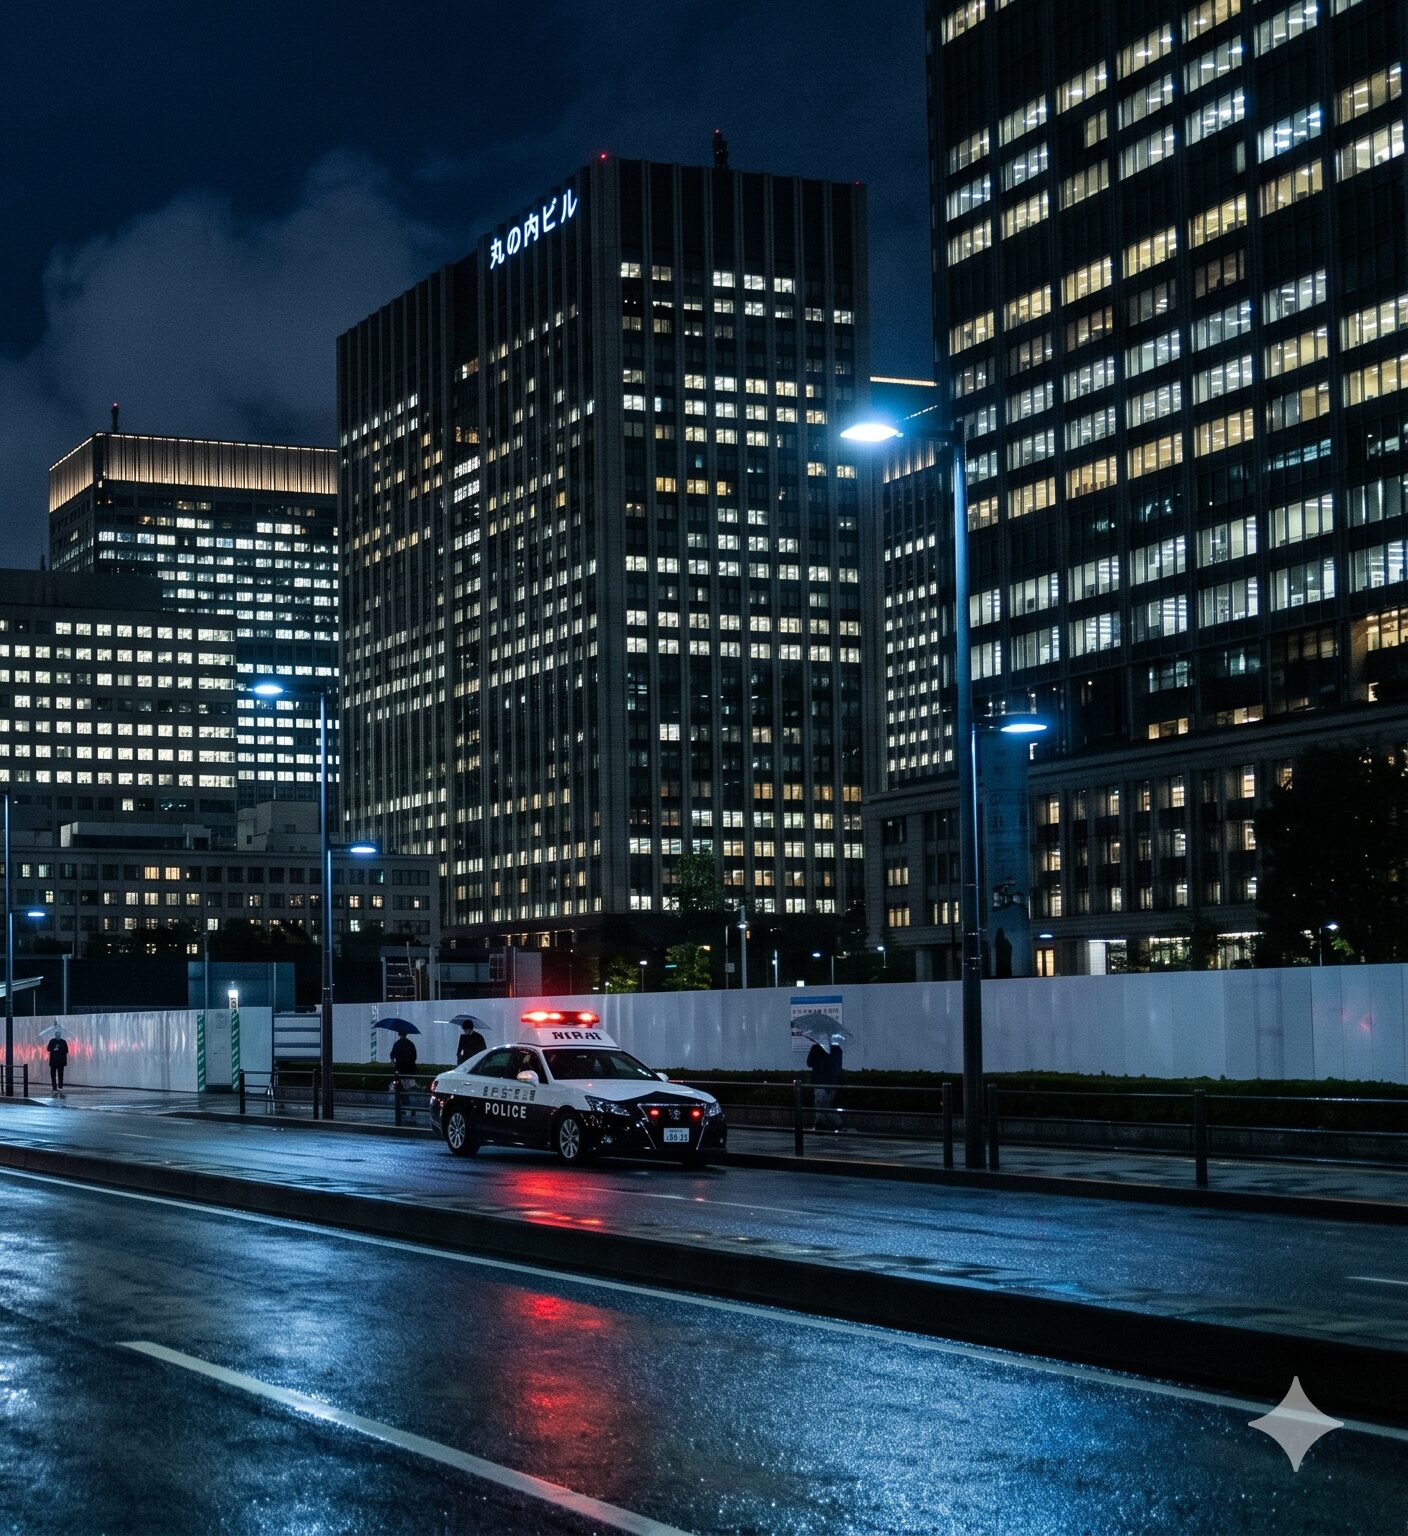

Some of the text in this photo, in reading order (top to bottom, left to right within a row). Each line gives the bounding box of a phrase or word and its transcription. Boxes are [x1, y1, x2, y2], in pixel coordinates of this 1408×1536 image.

[490, 189, 577, 270] 丸の内ビル
[485, 1102, 527, 1119] POLICE
